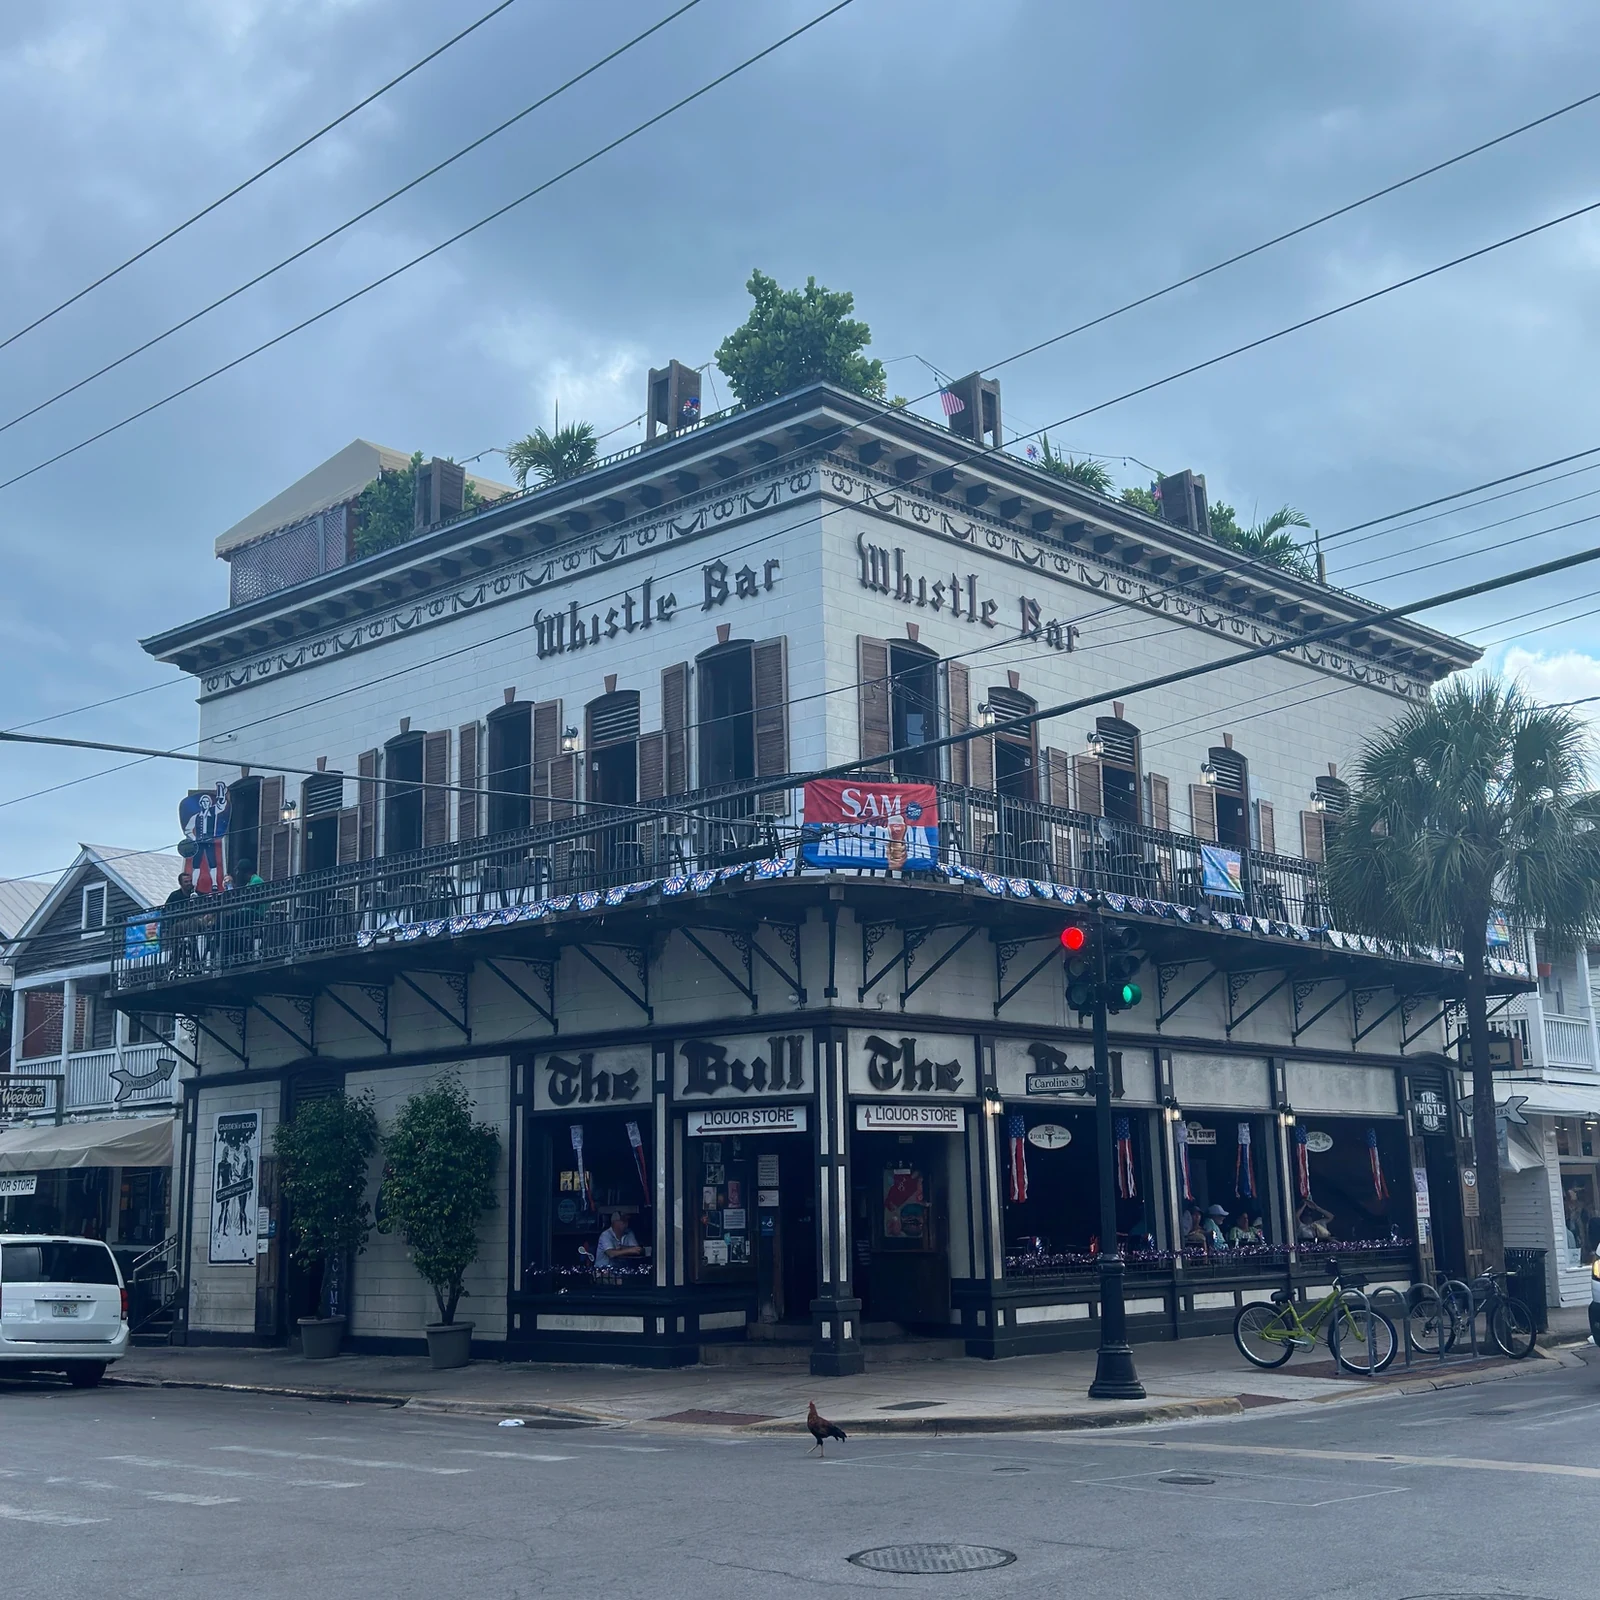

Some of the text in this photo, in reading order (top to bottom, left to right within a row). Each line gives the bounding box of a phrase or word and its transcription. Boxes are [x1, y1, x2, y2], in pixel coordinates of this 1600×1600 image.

[857, 531, 1080, 653] Whistle Bar
[534, 558, 779, 660] Whistle Bar
[841, 788, 903, 818] SAM
[545, 1035, 804, 1106] The Bull
[864, 1035, 964, 1092] The
[1034, 1077, 1080, 1089] Caroline St
[0, 1087, 45, 1107] Weekend
[1421, 1091, 1437, 1103] THE
[703, 1108, 795, 1126] LIQUOR STORE
[876, 1108, 958, 1122] LIQUOR STORE
[1423, 1115, 1439, 1127] BAR
[13, 1179, 35, 1191] STORE
